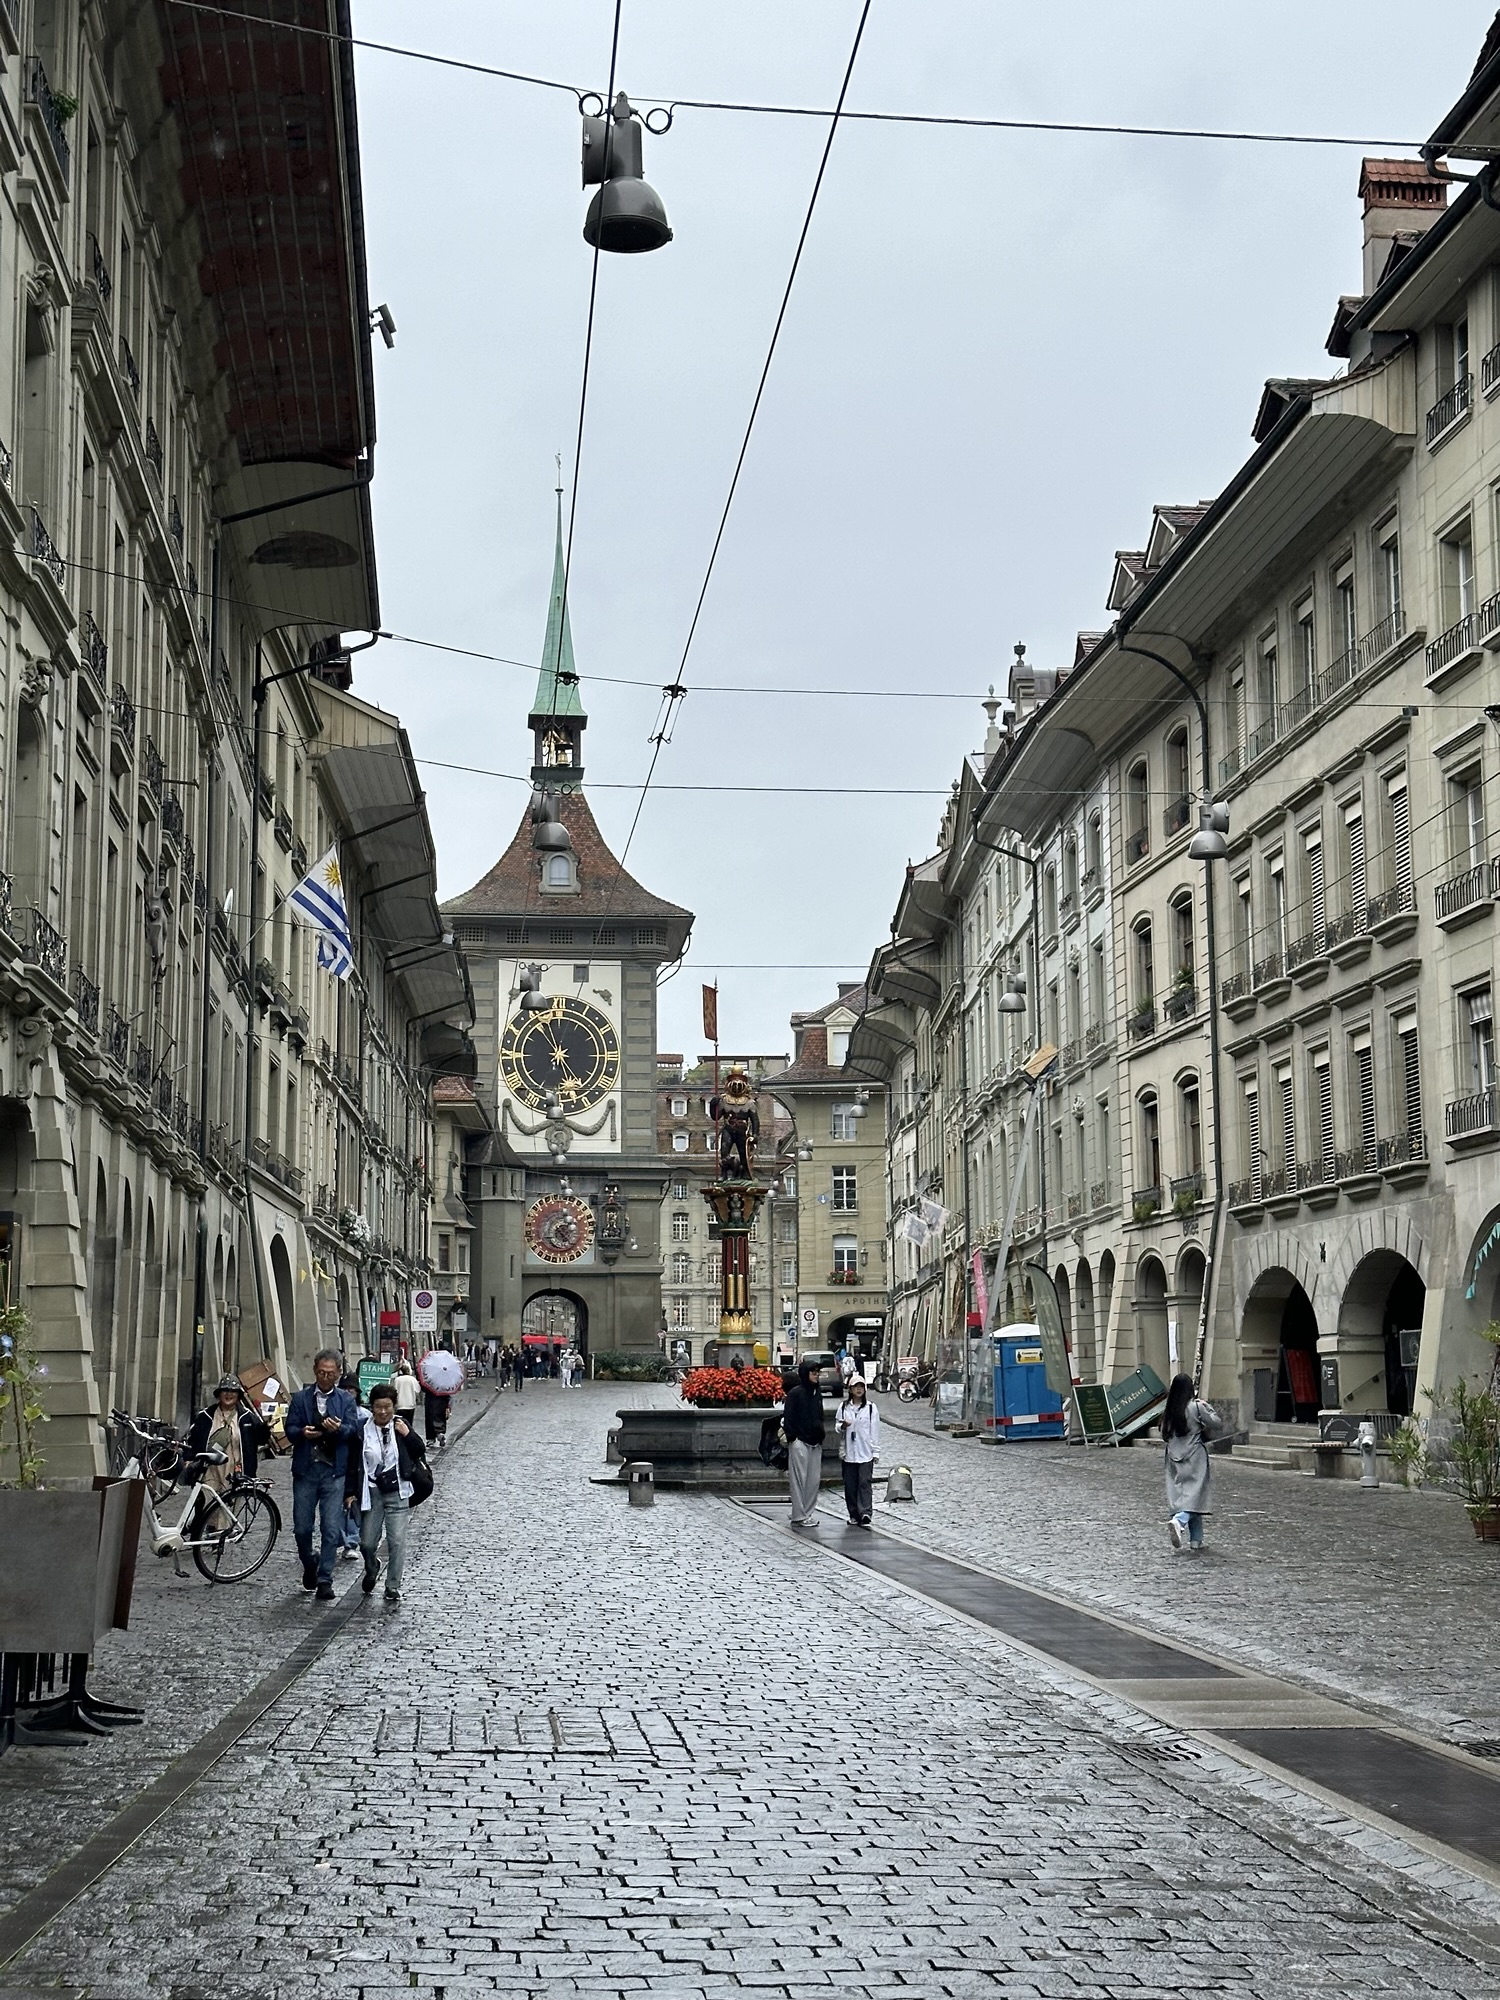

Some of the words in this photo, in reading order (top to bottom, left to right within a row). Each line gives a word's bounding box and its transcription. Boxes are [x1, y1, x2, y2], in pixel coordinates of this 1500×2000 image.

[552, 997, 566, 1009] XII
[582, 1005, 590, 1016] I
[600, 1023, 612, 1035] II
[606, 1050, 619, 1061] III
